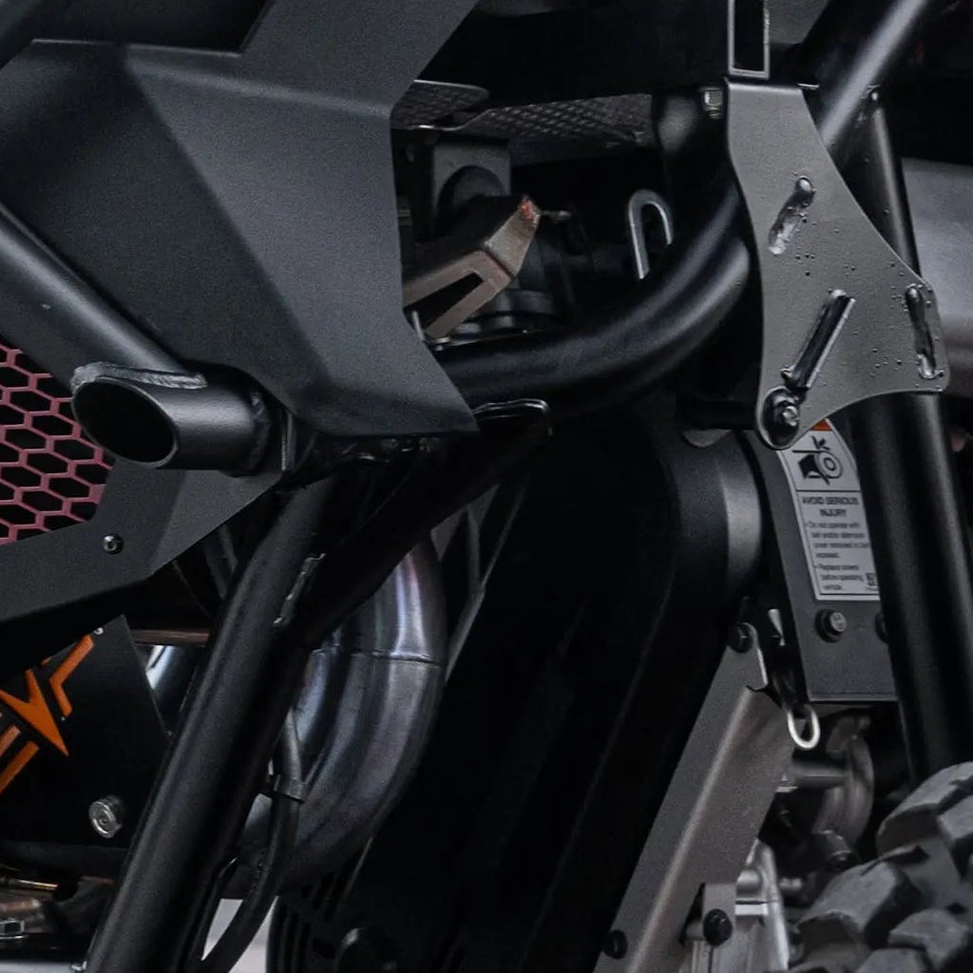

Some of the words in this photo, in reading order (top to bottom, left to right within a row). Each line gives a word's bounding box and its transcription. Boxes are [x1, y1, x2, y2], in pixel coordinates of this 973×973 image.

[802, 496, 824, 505] AVOID
[826, 496, 859, 506] SERIOUS
[819, 508, 846, 517] INJURY
